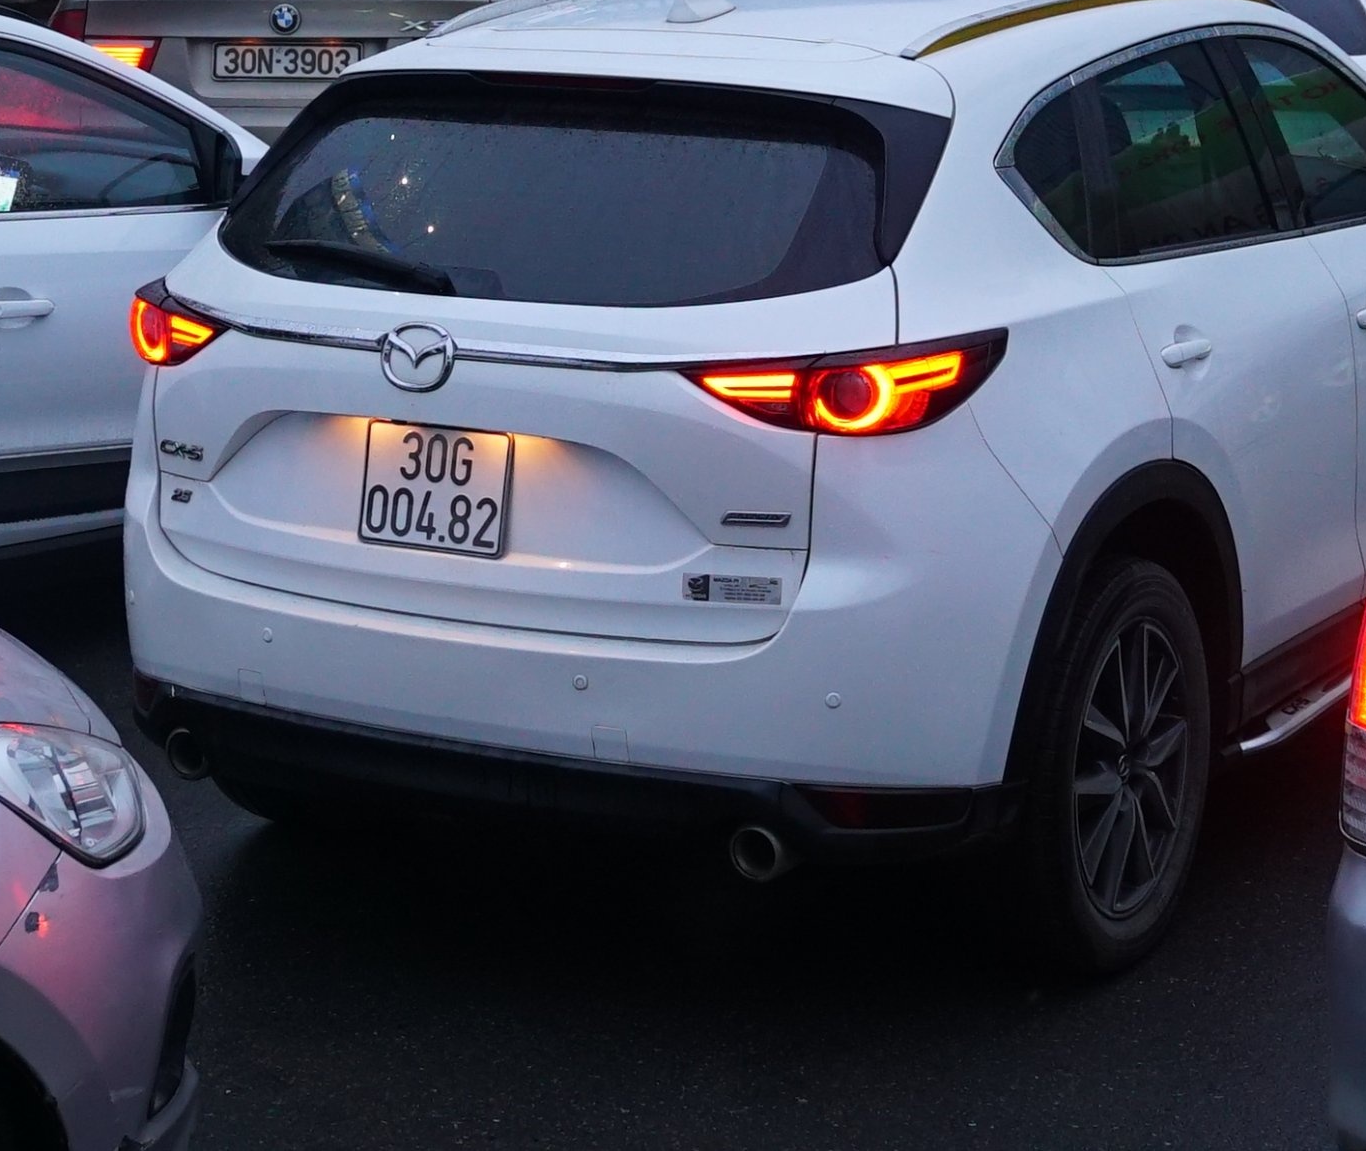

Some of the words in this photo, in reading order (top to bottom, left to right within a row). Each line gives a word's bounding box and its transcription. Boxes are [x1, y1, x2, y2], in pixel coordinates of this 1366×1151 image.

[224, 47, 352, 75] 30N-3903
[399, 431, 474, 487] 30G
[364, 483, 500, 550] 004.82
